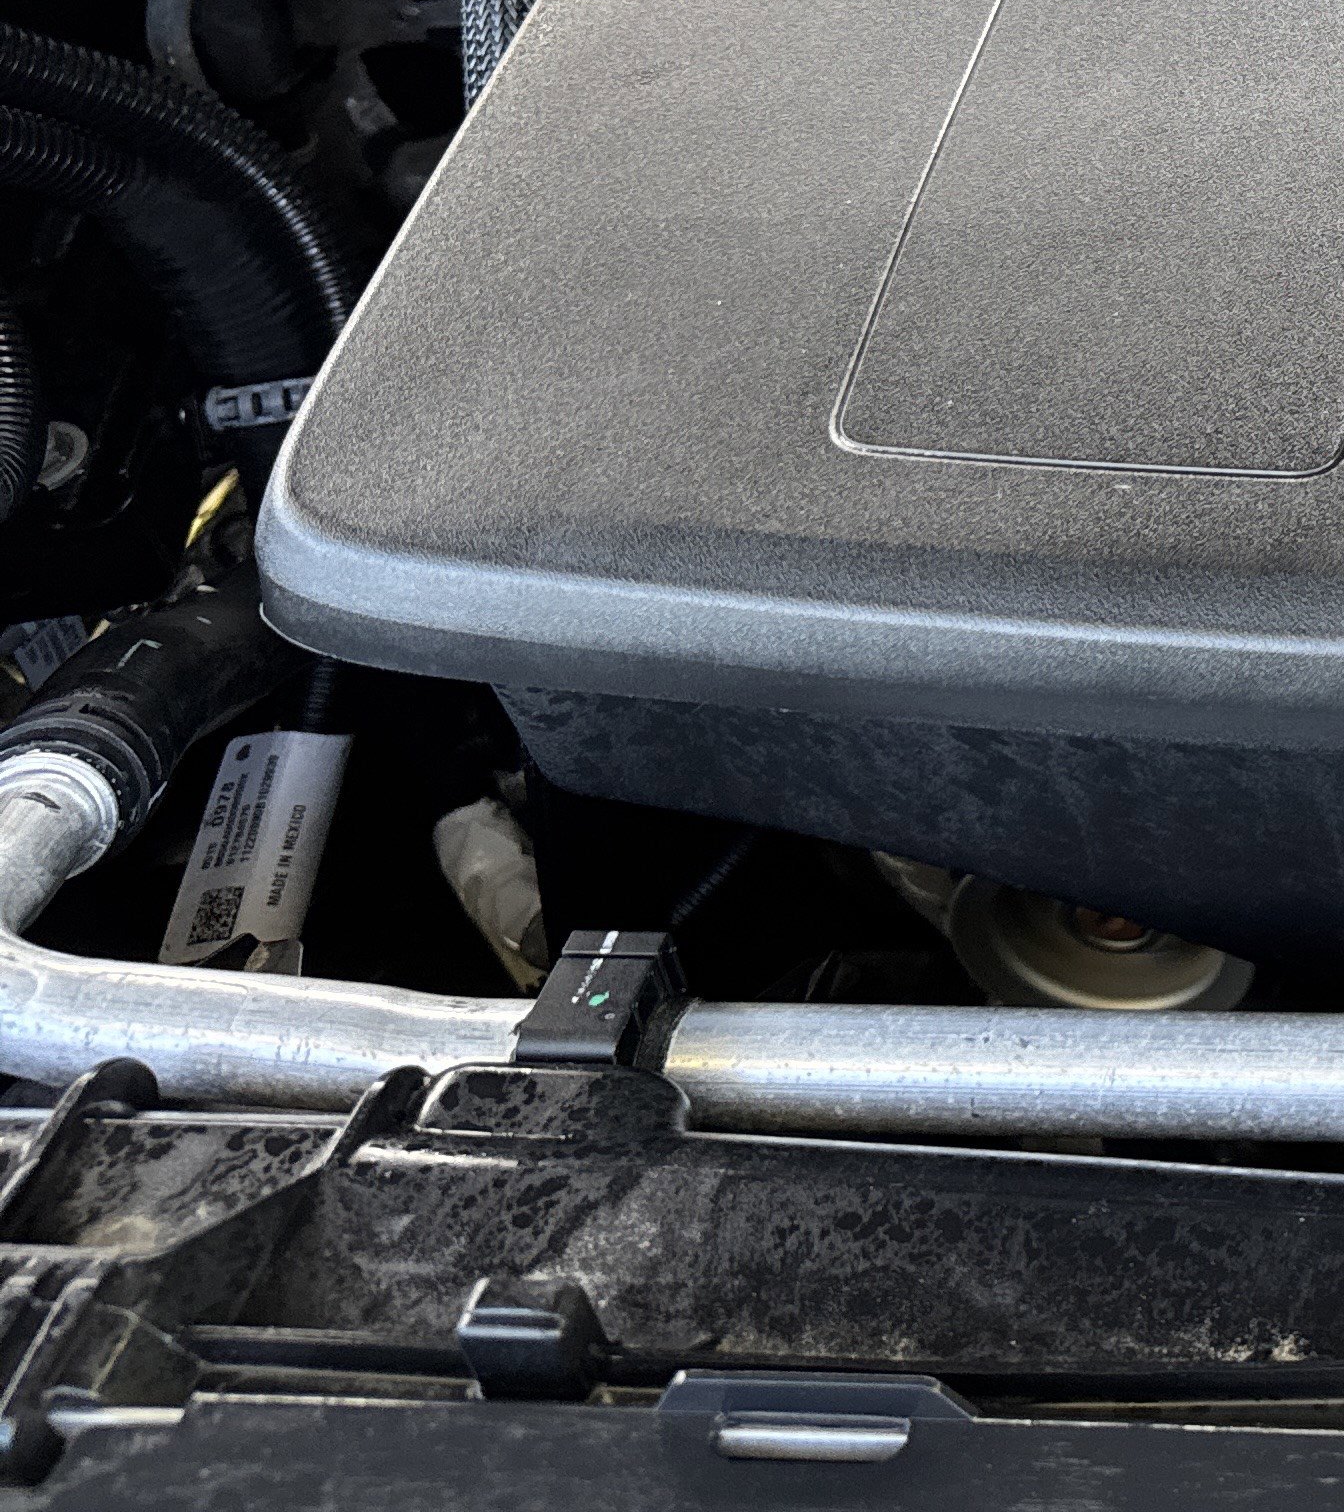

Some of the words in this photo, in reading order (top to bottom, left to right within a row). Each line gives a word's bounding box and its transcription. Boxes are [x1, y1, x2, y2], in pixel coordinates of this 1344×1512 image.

[283, 804, 307, 850] MEXICO
[277, 854, 293, 868] IN
[267, 871, 289, 907] MADE
